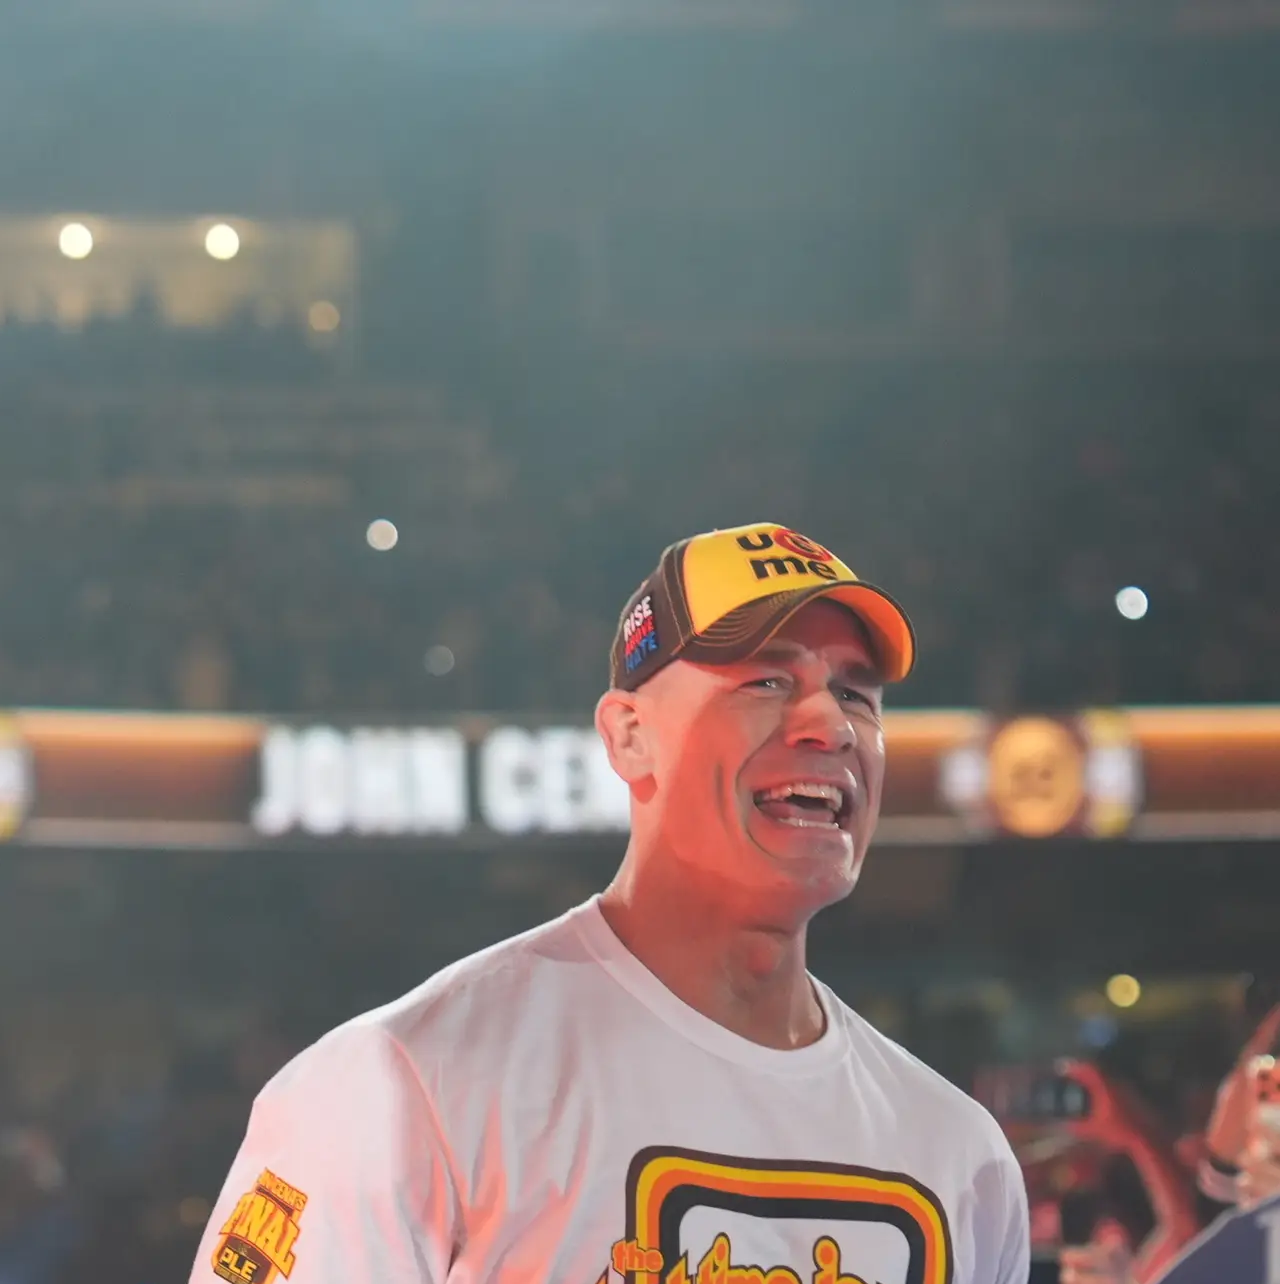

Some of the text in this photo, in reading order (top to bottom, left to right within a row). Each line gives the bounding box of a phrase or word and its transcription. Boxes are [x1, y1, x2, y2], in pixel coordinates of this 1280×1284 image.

[749, 556, 838, 580] me
[623, 596, 652, 642] RISE
[253, 725, 629, 835] JOHN CEN
[220, 1247, 257, 1280] PLE
[612, 1239, 663, 1276] the
